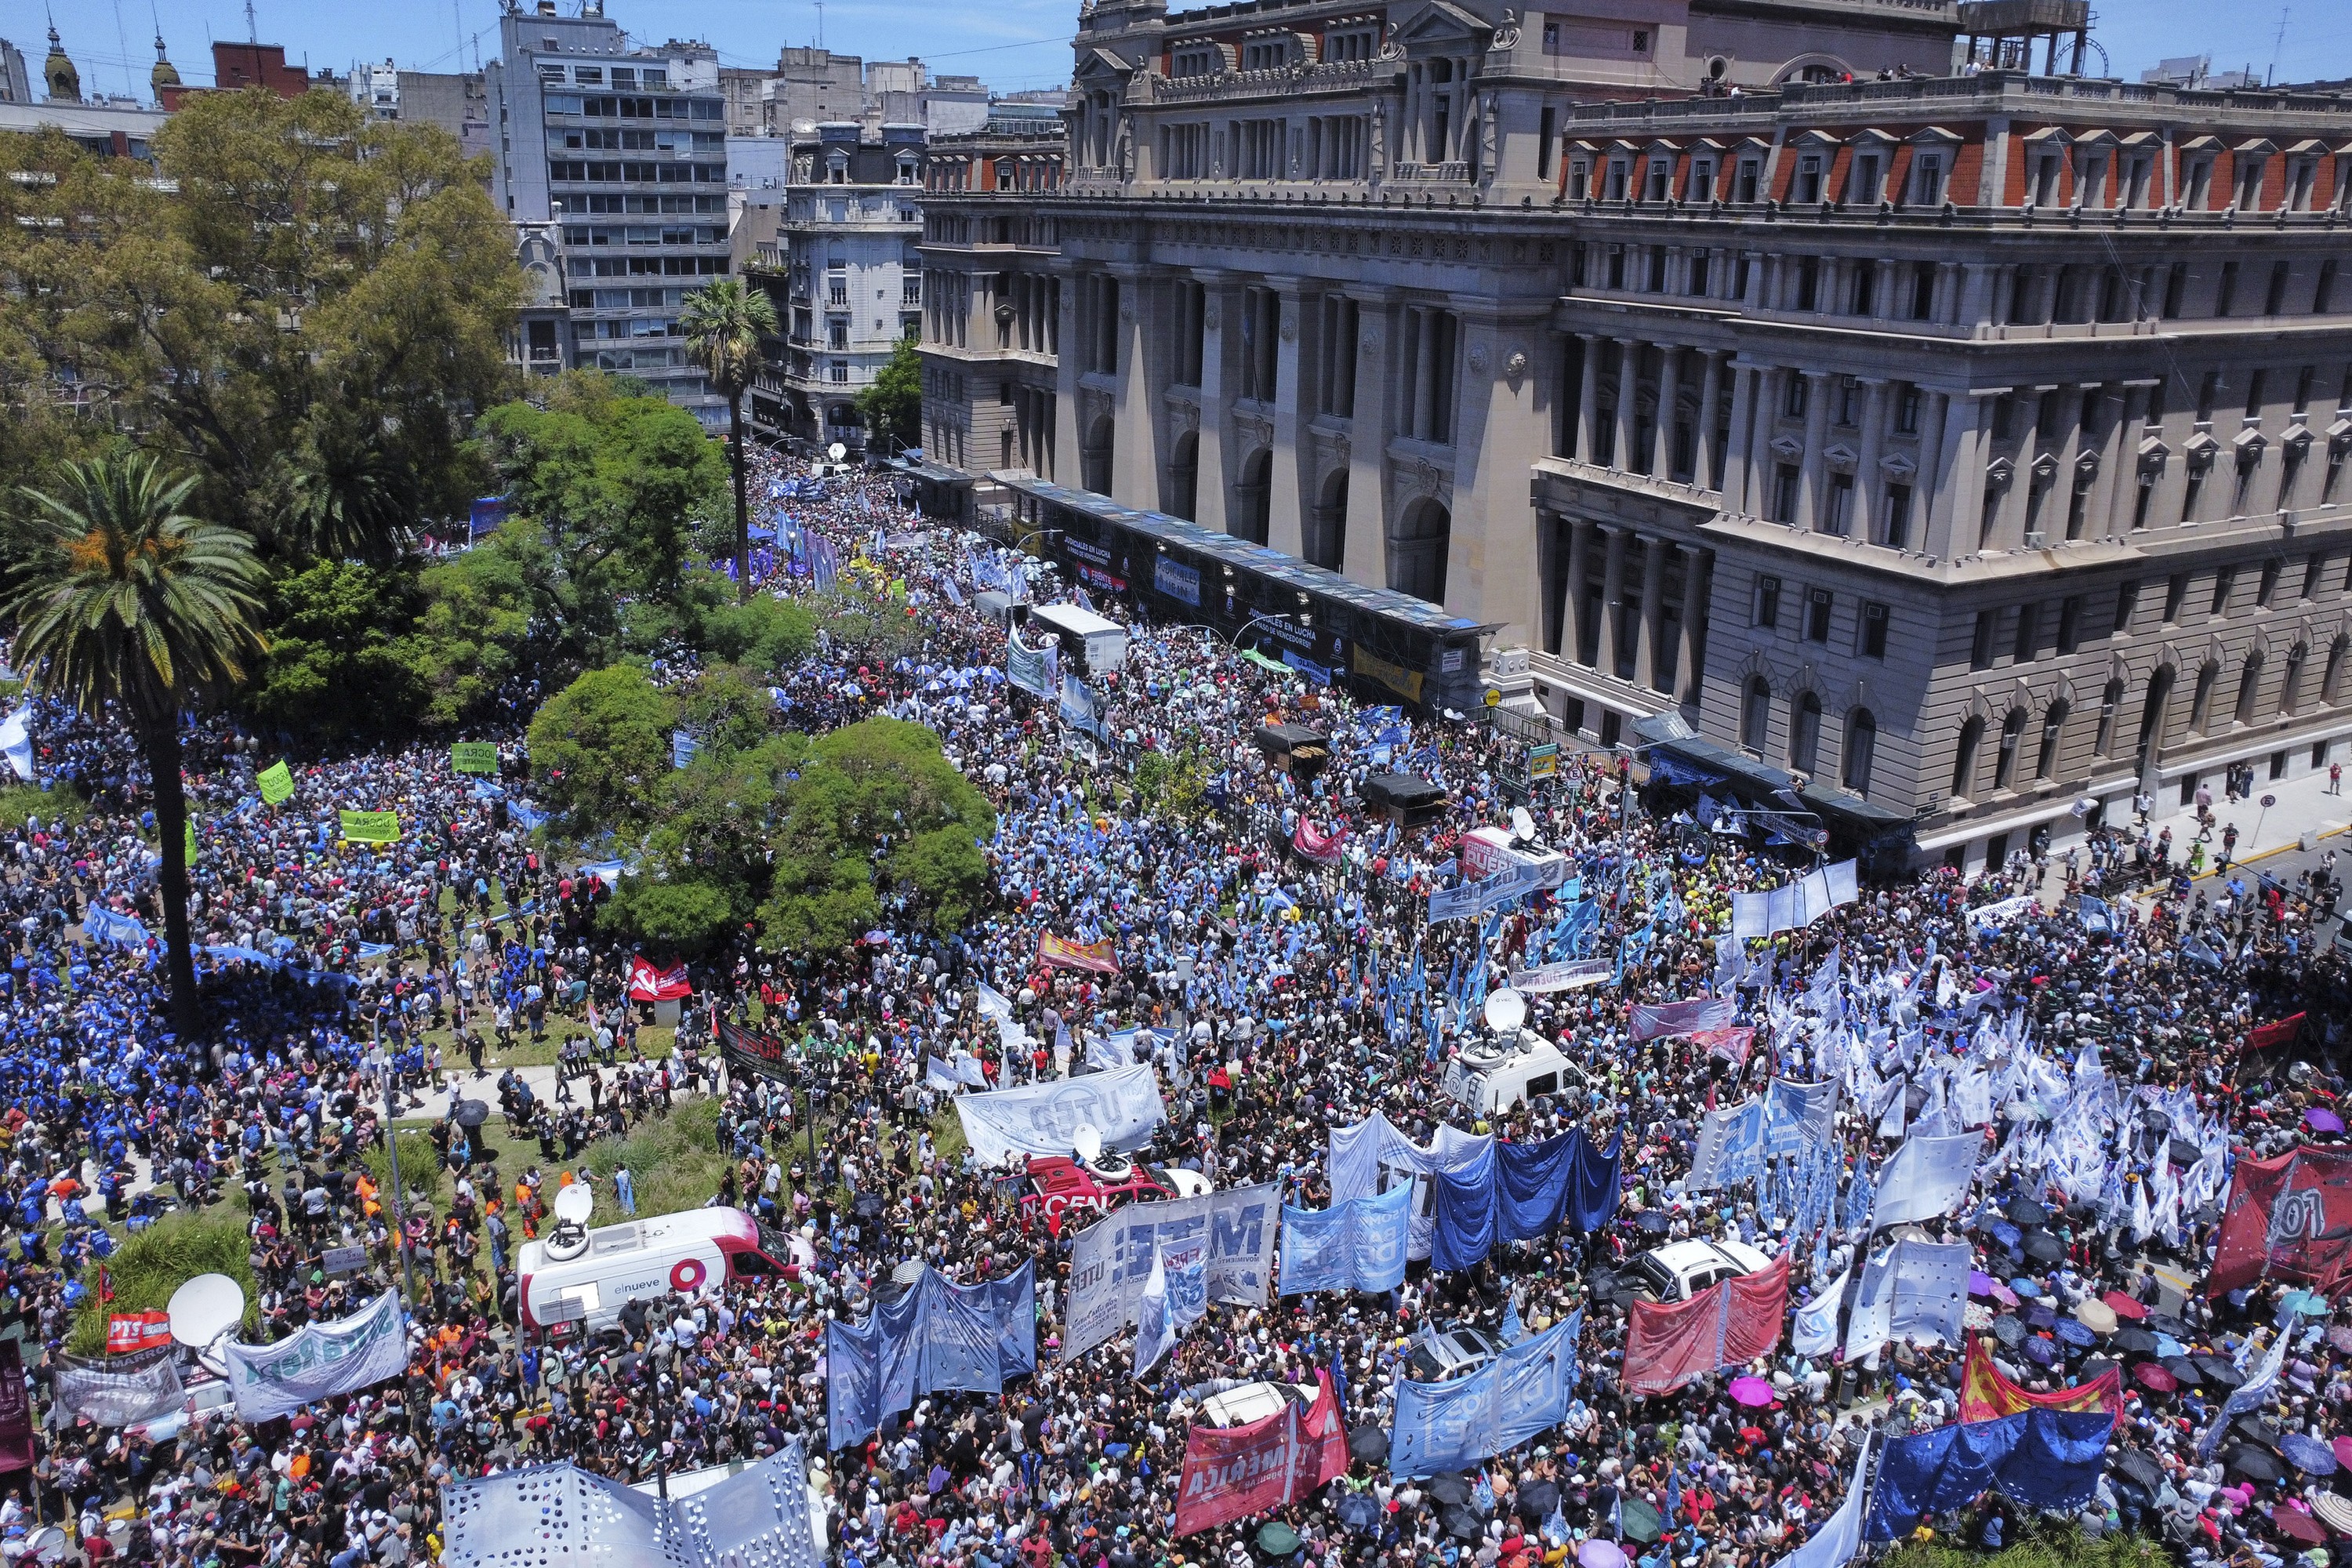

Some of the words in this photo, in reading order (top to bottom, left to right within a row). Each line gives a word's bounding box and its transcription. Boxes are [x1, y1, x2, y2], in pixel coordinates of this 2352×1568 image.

[1248, 607, 1283, 628] JUDICIALES
[1284, 622, 1294, 632] EN
[1294, 624, 1316, 641] LUCHA
[1256, 622, 1269, 633] PASO
[1818, 833, 1827, 842] 20
[1466, 840, 1491, 855] FIRME
[1492, 847, 1519, 864] JUNTO
[1045, 1195, 1107, 1217] C5N
[615, 1279, 660, 1294] elnueve
[110, 1321, 143, 1338] PTS
